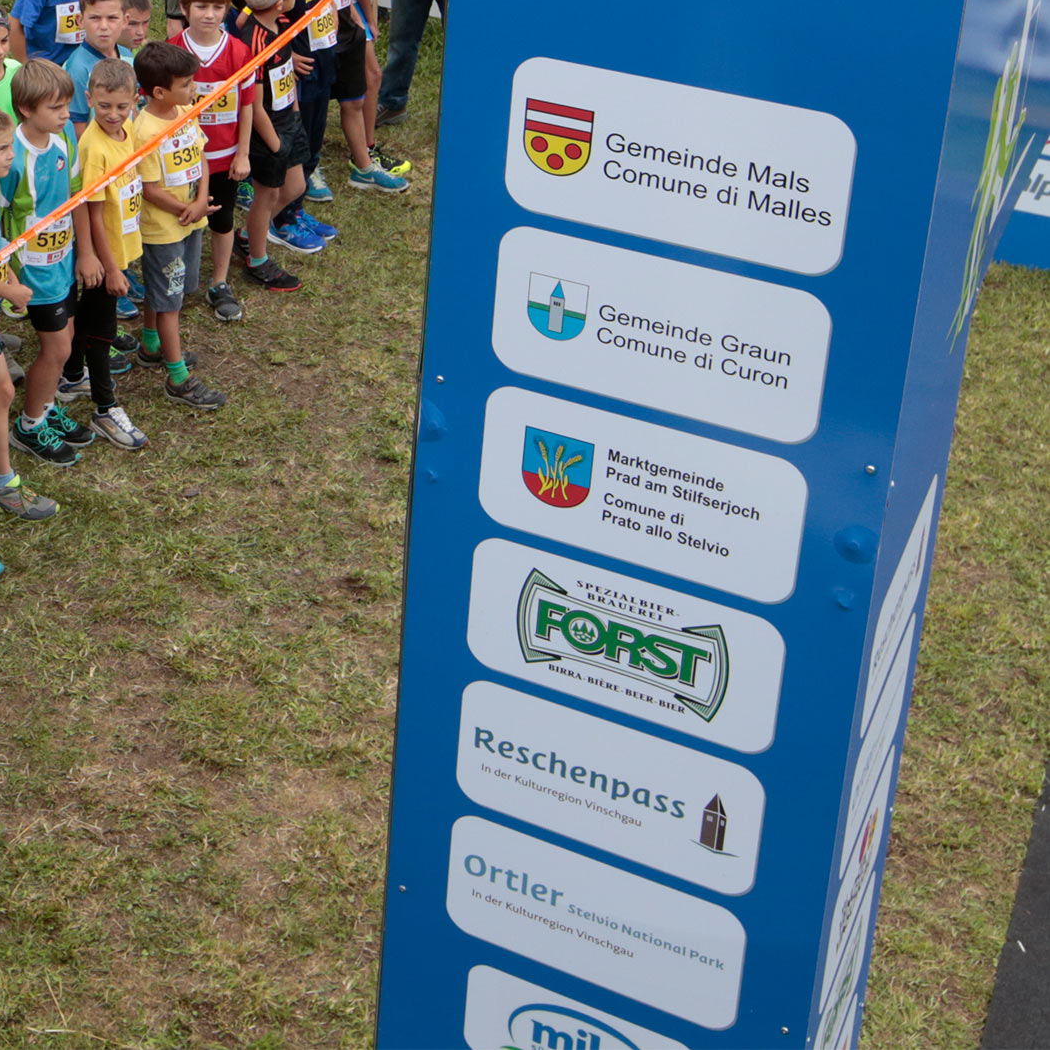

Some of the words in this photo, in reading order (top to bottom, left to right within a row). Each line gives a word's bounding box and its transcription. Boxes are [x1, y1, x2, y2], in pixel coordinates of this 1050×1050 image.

[603, 160, 708, 200] Comune
[716, 186, 738, 206] di
[747, 190, 833, 227] Malles
[605, 132, 738, 179] Gemeinde
[747, 161, 811, 194] Mals
[596, 327, 687, 363] Comune
[694, 352, 713, 370] di
[721, 358, 789, 390] Curon
[598, 304, 713, 346] Gemeinde
[721, 335, 792, 367] Graun
[605, 466, 641, 487] Prad
[644, 479, 668, 494] am
[672, 485, 760, 521] Stilfserjoch
[607, 448, 725, 492] Marktgemeinde
[601, 509, 642, 532] Prato
[644, 522, 673, 542] allo
[677, 531, 730, 558] Stelvio
[603, 492, 666, 521] Comune
[670, 511, 685, 526] di
[576, 579, 680, 617] SPEZIALBIER-
[587, 593, 664, 622] BRAUEREI
[535, 598, 712, 688] FORST
[474, 726, 685, 819] Reschenpass
[481, 763, 492, 773] In
[494, 767, 512, 781] der
[514, 774, 582, 806] Kulturregion
[585, 799, 642, 827] Vinschgau
[464, 854, 564, 907] Ortler
[568, 903, 619, 930] Stelvio
[621, 923, 687, 956] National
[689, 949, 724, 971] Park
[471, 888, 482, 898] In
[484, 893, 502, 907] der
[505, 901, 573, 934] Kulturregion
[576, 928, 634, 958] Vinschgau
